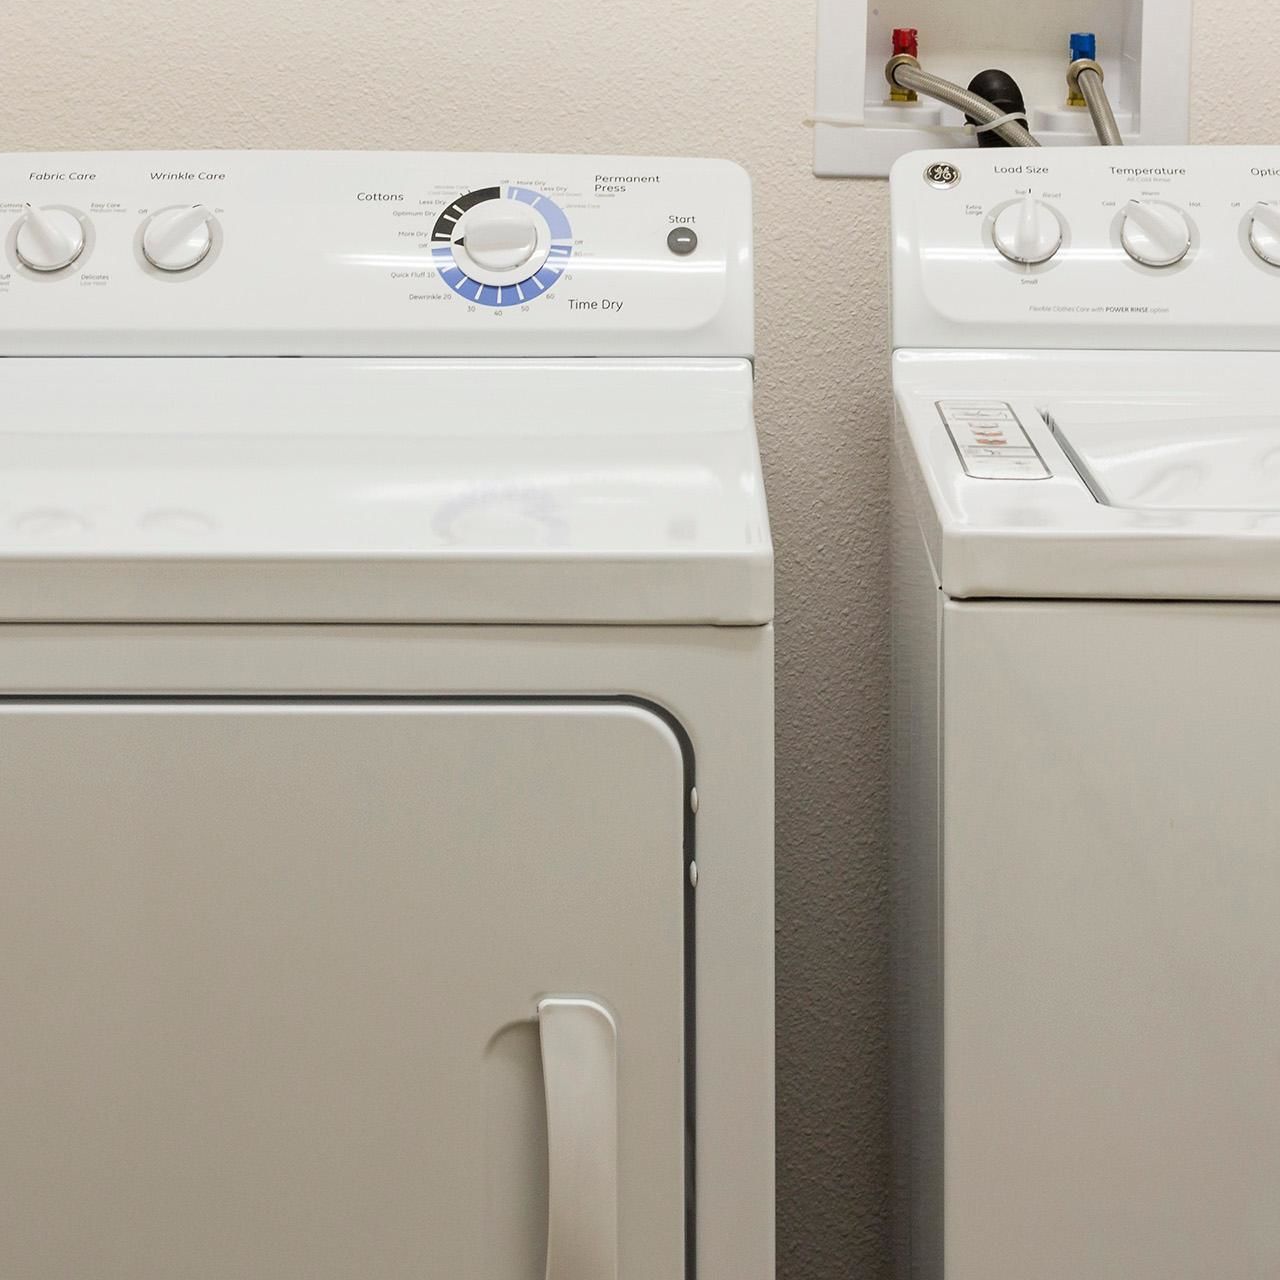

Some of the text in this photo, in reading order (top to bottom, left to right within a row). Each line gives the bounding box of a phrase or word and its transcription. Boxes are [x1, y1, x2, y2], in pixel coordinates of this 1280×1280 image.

[994, 165, 1050, 174] Load Size
[1110, 166, 1187, 176] Temperature
[28, 171, 97, 181] Fabric Care
[150, 171, 226, 180] Wrinkle Care
[594, 174, 661, 183] Permanent
[594, 184, 626, 192] Press
[356, 192, 404, 201] Cottons
[668, 215, 696, 224] Start
[390, 271, 409, 279] Quick
[408, 293, 442, 301] Dewrinkle
[568, 299, 624, 312] Time Dry
